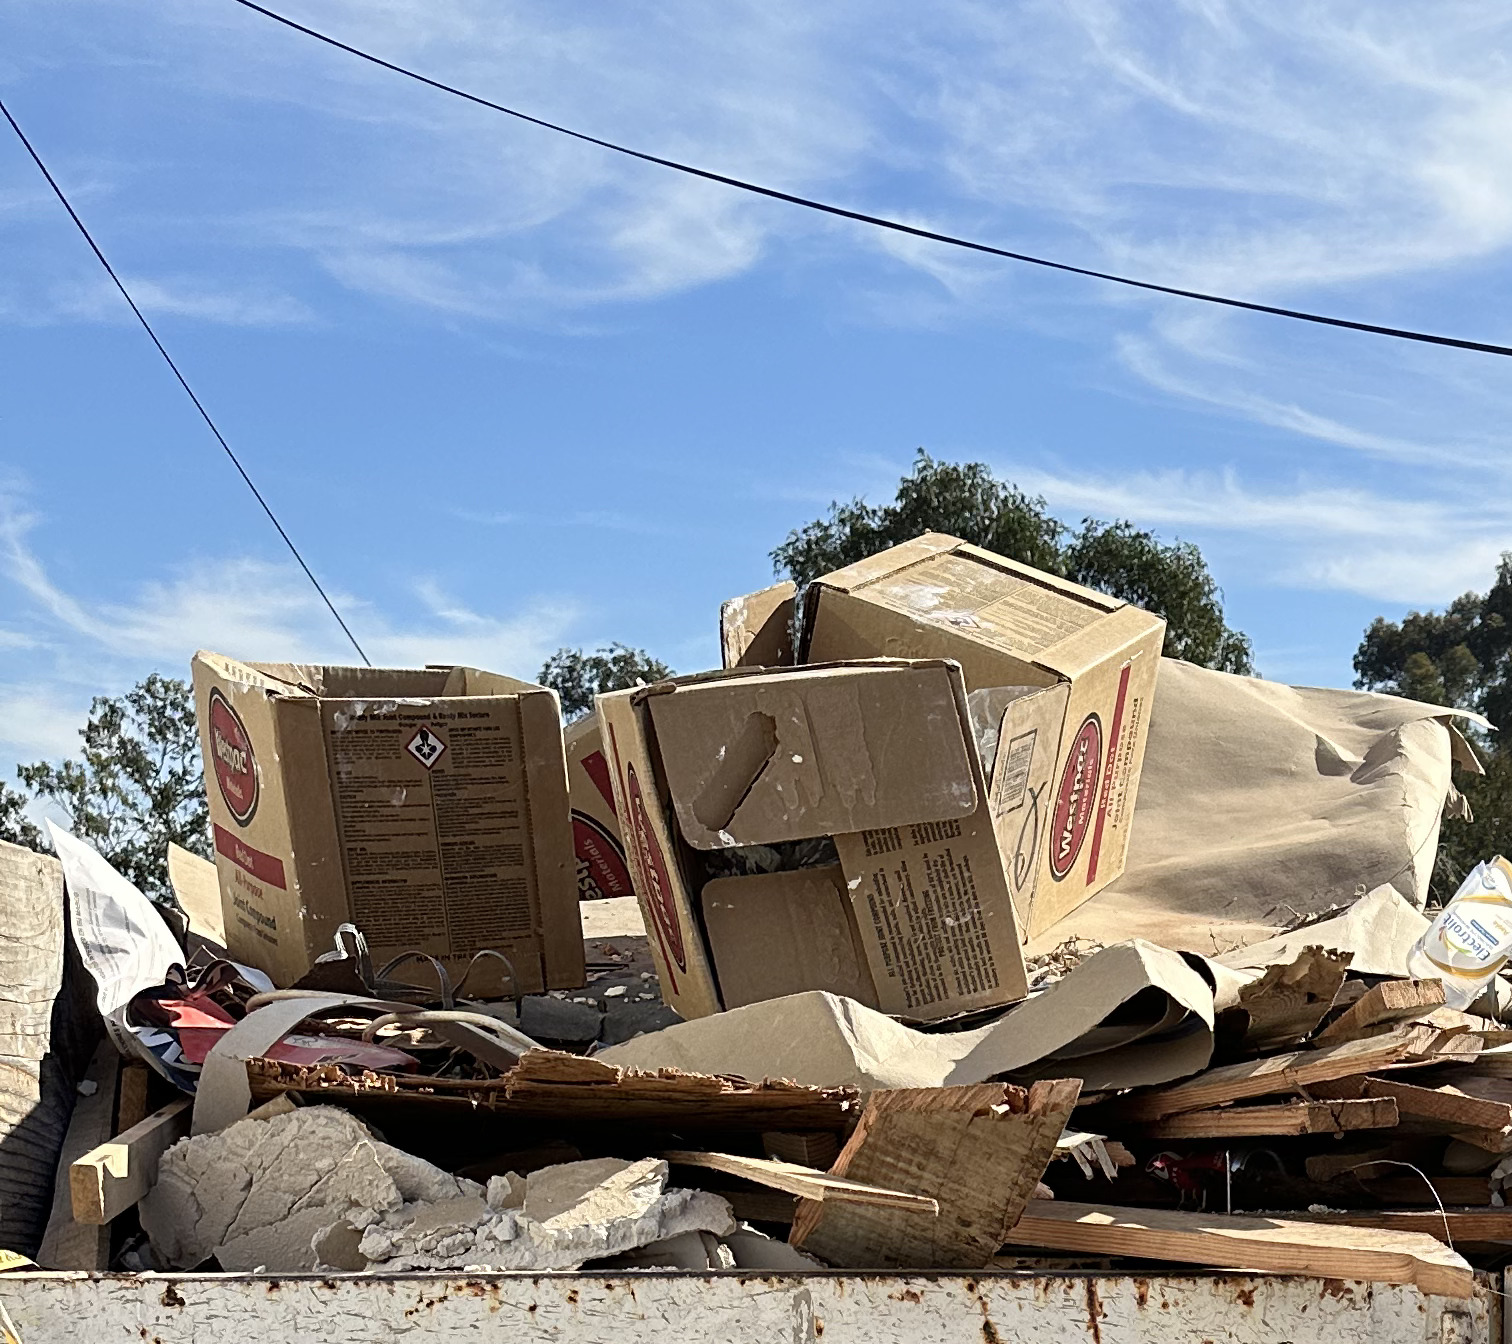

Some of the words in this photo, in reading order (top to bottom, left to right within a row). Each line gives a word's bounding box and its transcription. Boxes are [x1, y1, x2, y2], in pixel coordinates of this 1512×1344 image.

[1058, 736, 1091, 861] Westpac
[1112, 791, 1124, 831] Joint
[583, 837, 623, 893] Materials
[1443, 912, 1491, 961] Electrolit
